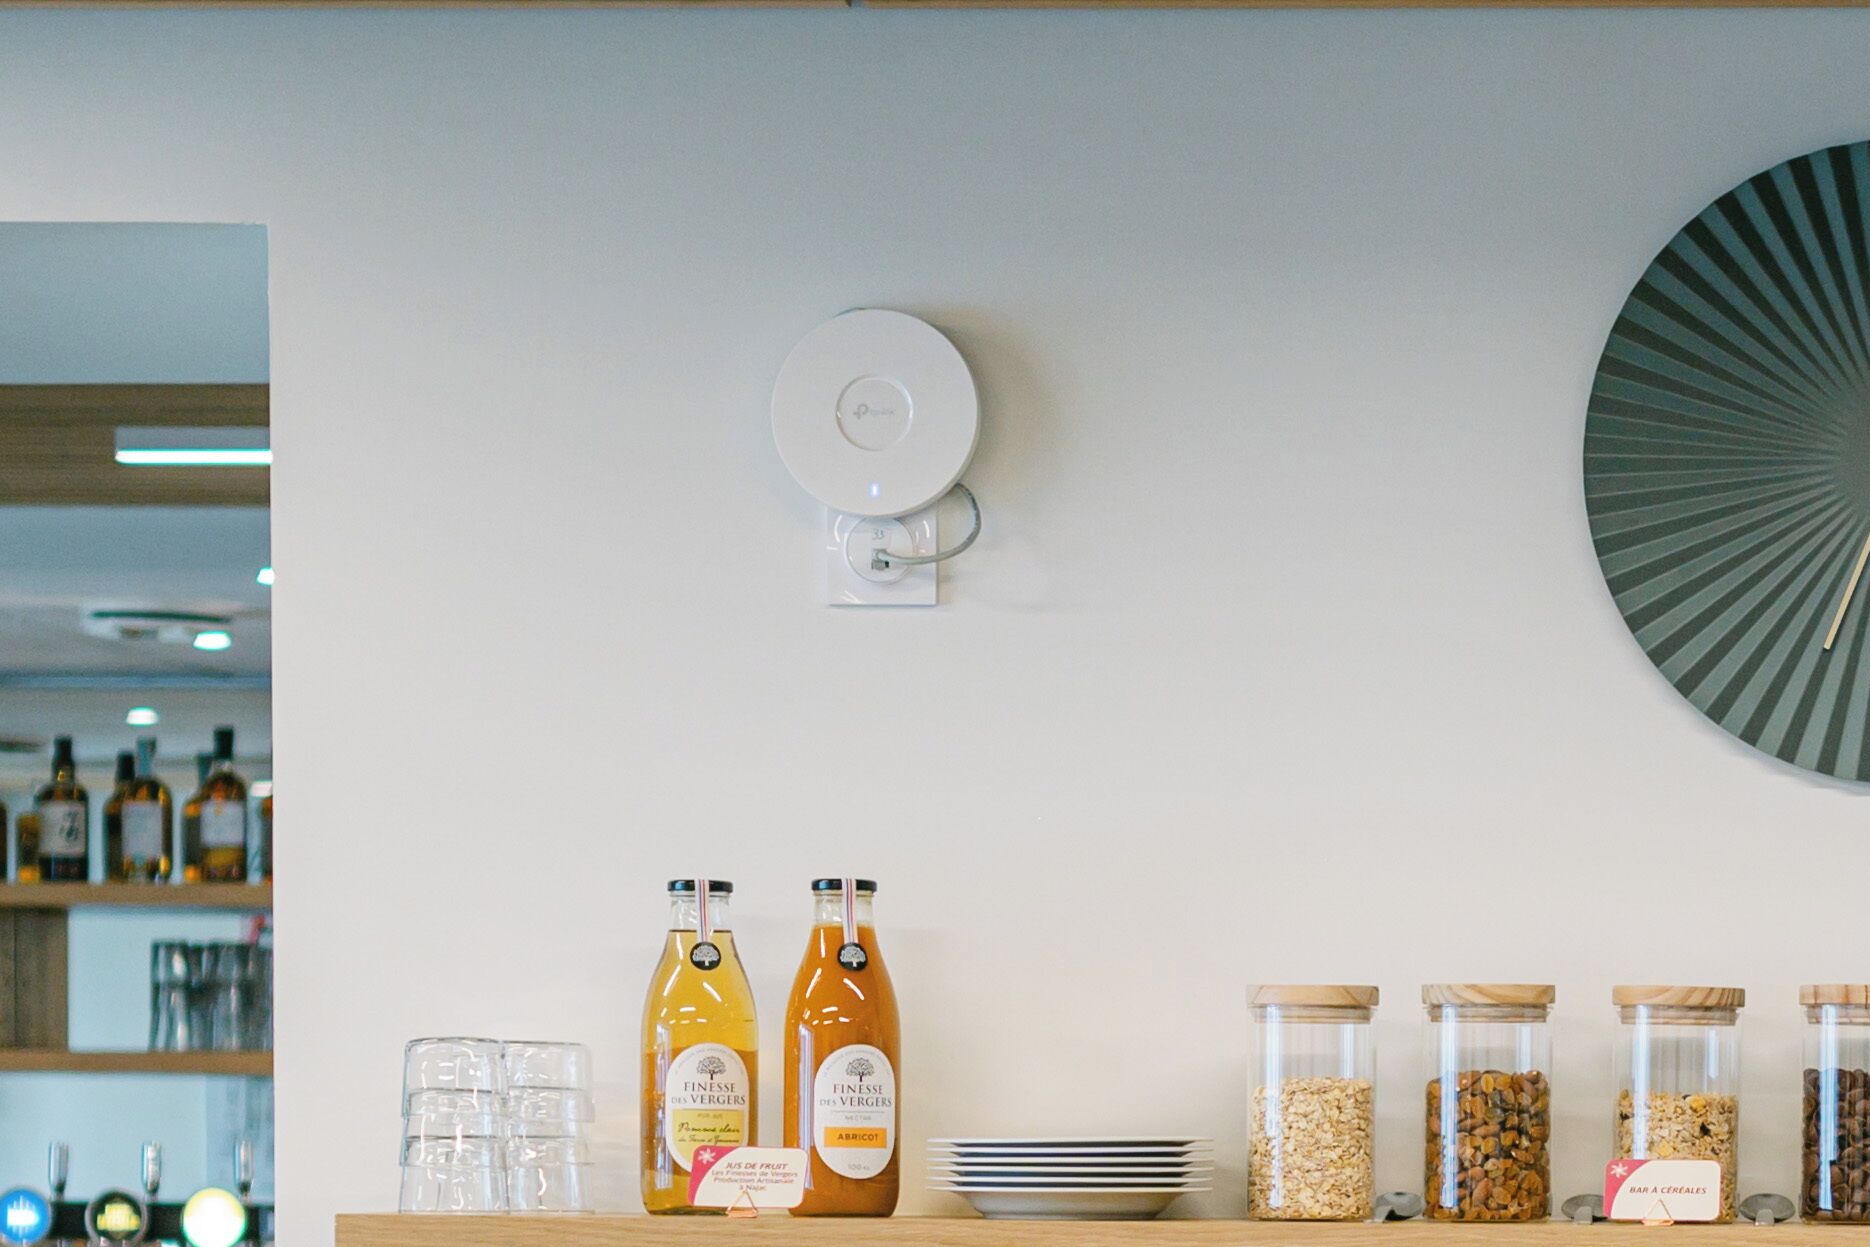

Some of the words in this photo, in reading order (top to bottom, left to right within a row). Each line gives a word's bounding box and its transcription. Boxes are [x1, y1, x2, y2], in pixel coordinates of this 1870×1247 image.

[684, 1081, 737, 1093] FINESSE
[833, 1083, 883, 1094] FINESSE
[671, 1096, 687, 1104] DES
[690, 1094, 746, 1106] VERGERS
[840, 1096, 892, 1107] VERGERS
[837, 1133, 879, 1141] ABRICOT
[1660, 1184, 1707, 1194] CÉRÉALES
